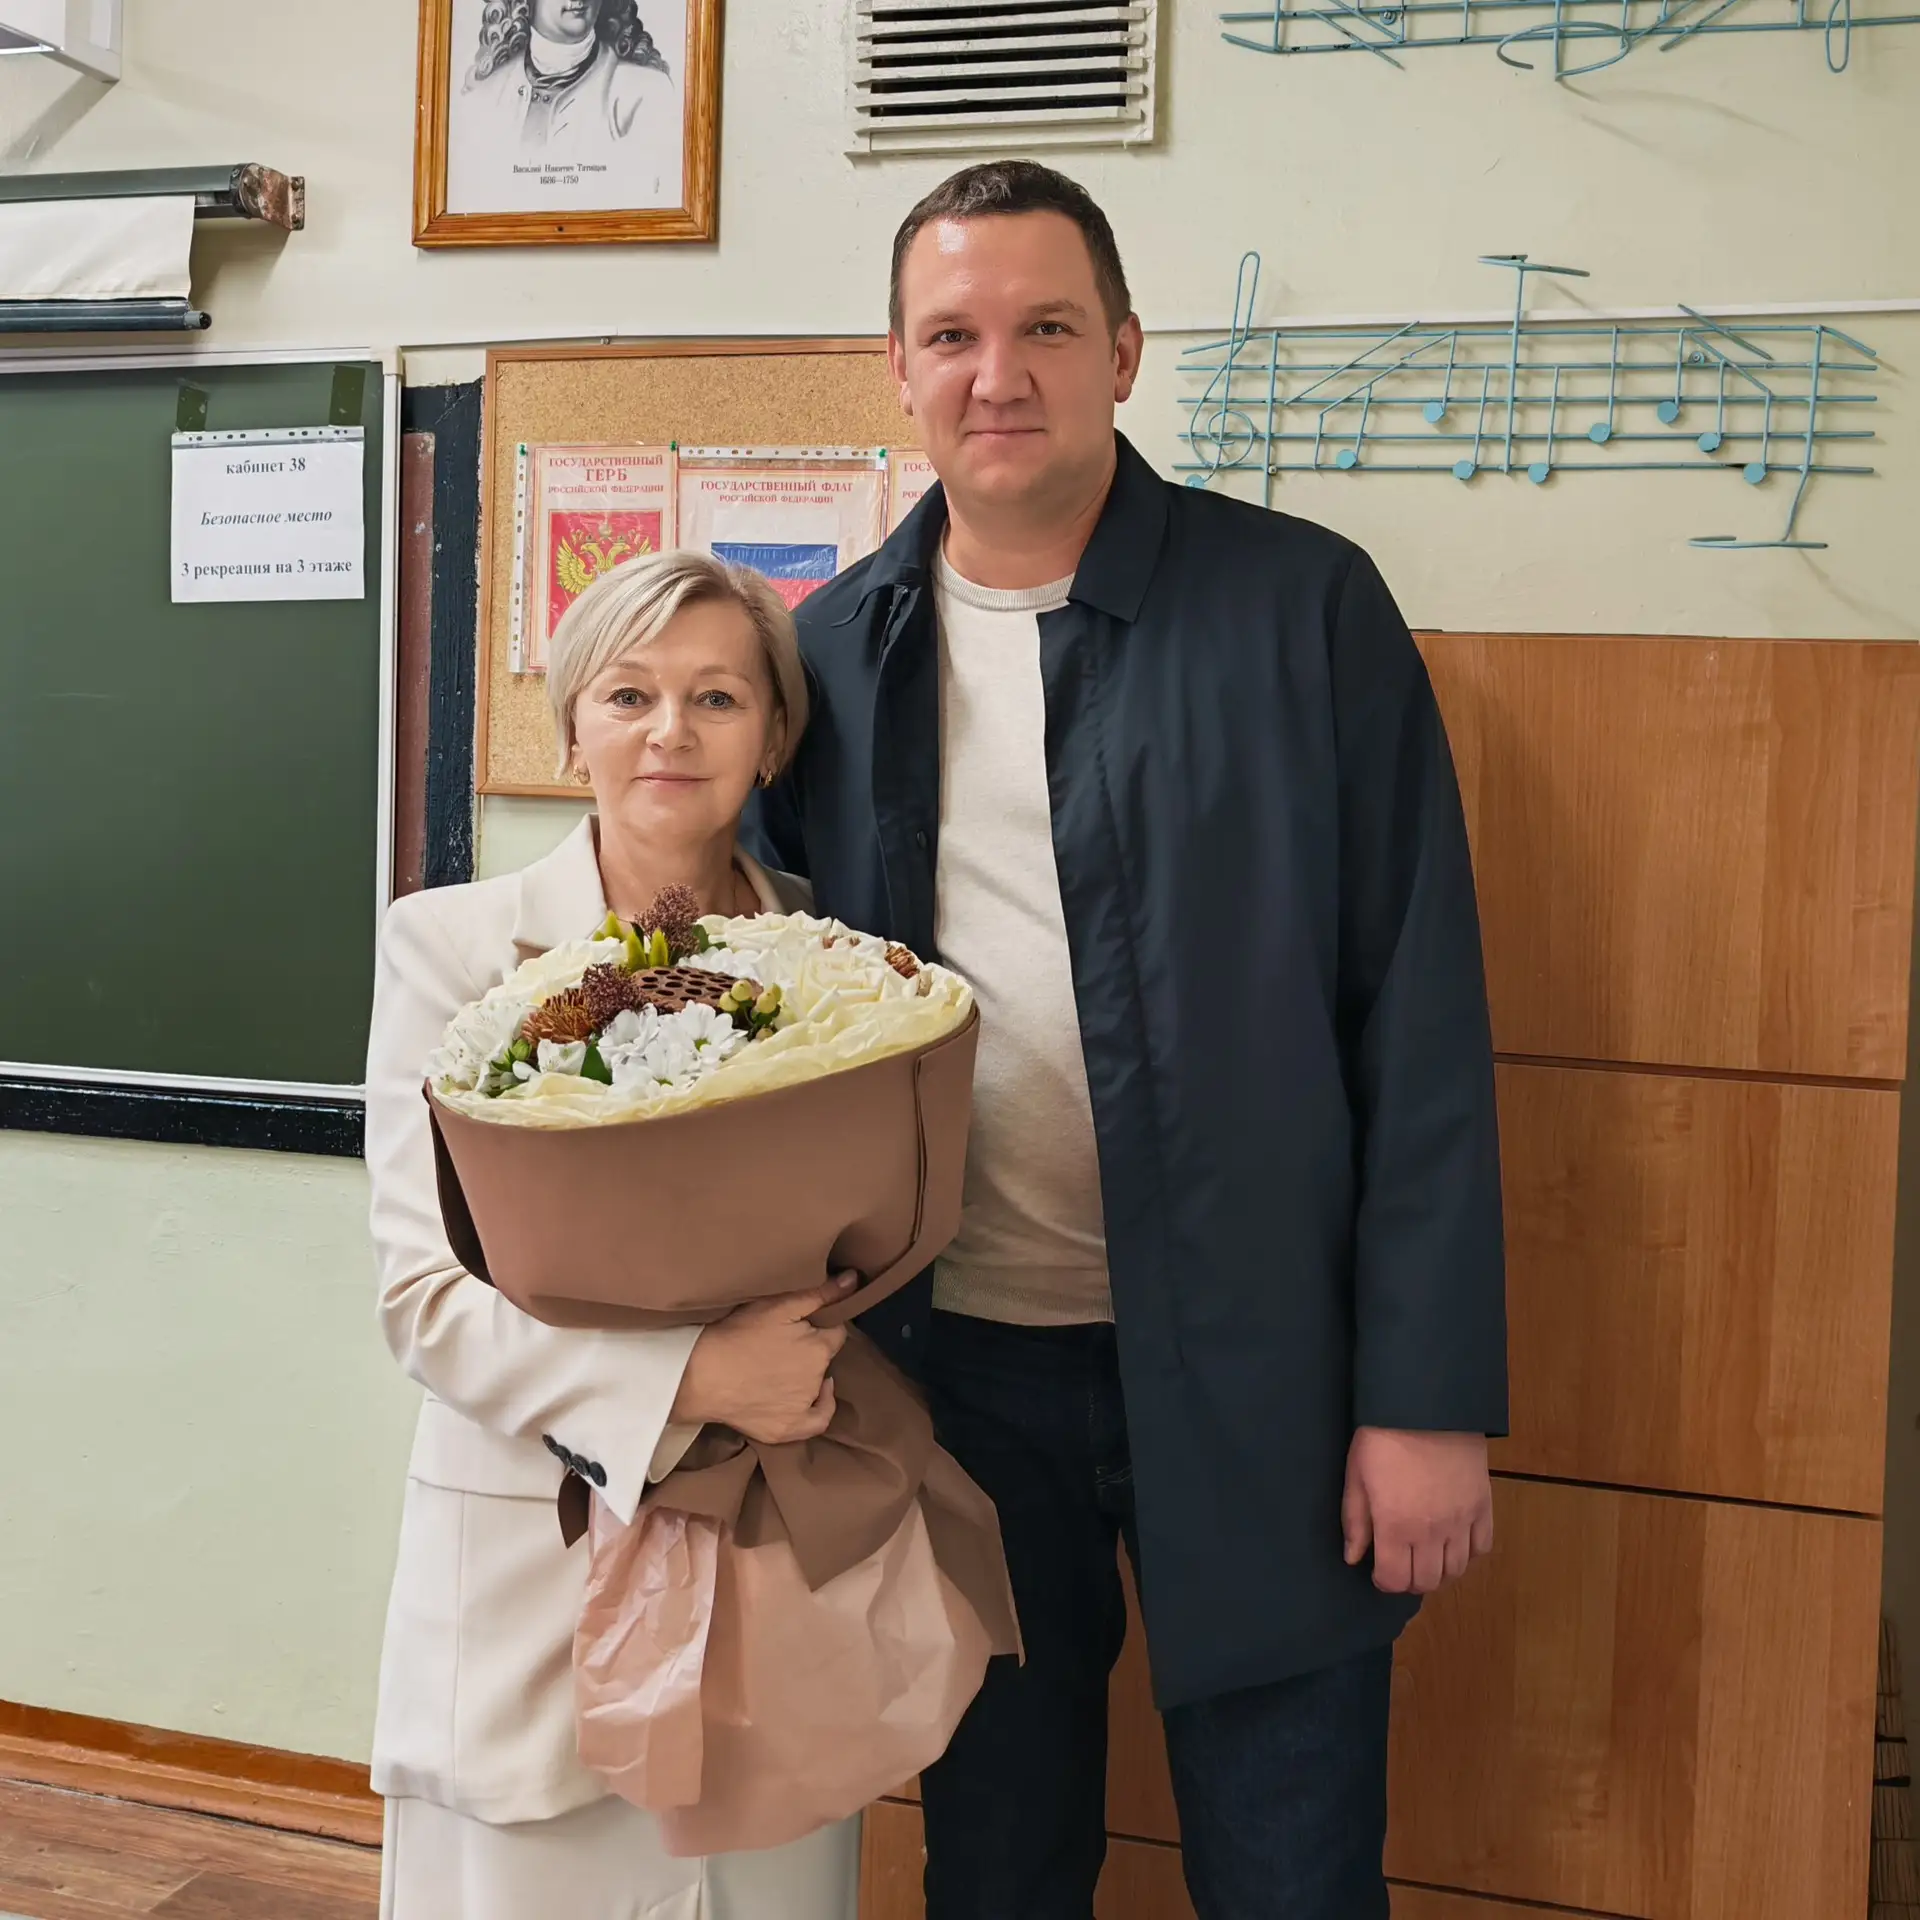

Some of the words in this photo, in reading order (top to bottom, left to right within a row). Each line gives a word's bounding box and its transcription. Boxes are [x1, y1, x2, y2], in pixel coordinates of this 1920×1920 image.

[226, 459, 284, 474] кабинет
[289, 457, 306, 472] 38
[549, 455, 663, 467] ГОСУДАРСТВЕННЫЙ
[585, 468, 628, 482] ГЕРБ
[548, 485, 608, 494] РОССИЙСКОЙ
[611, 484, 664, 493] ФЕДЕРАЦИИ
[701, 480, 816, 492] ГОСУДАРСТВЕННЫЙ
[821, 482, 853, 492] ФЛАГ
[719, 494, 777, 503] РОССИЙСКОЙ
[781, 495, 834, 504] ФЕДЕРАЦИИ
[200, 511, 281, 526] Безопасное
[284, 510, 332, 523] место
[181, 562, 189, 577] 3
[194, 562, 271, 580] рекреация
[276, 563, 292, 574] на
[297, 559, 305, 573] 3
[309, 560, 352, 573] этаже
